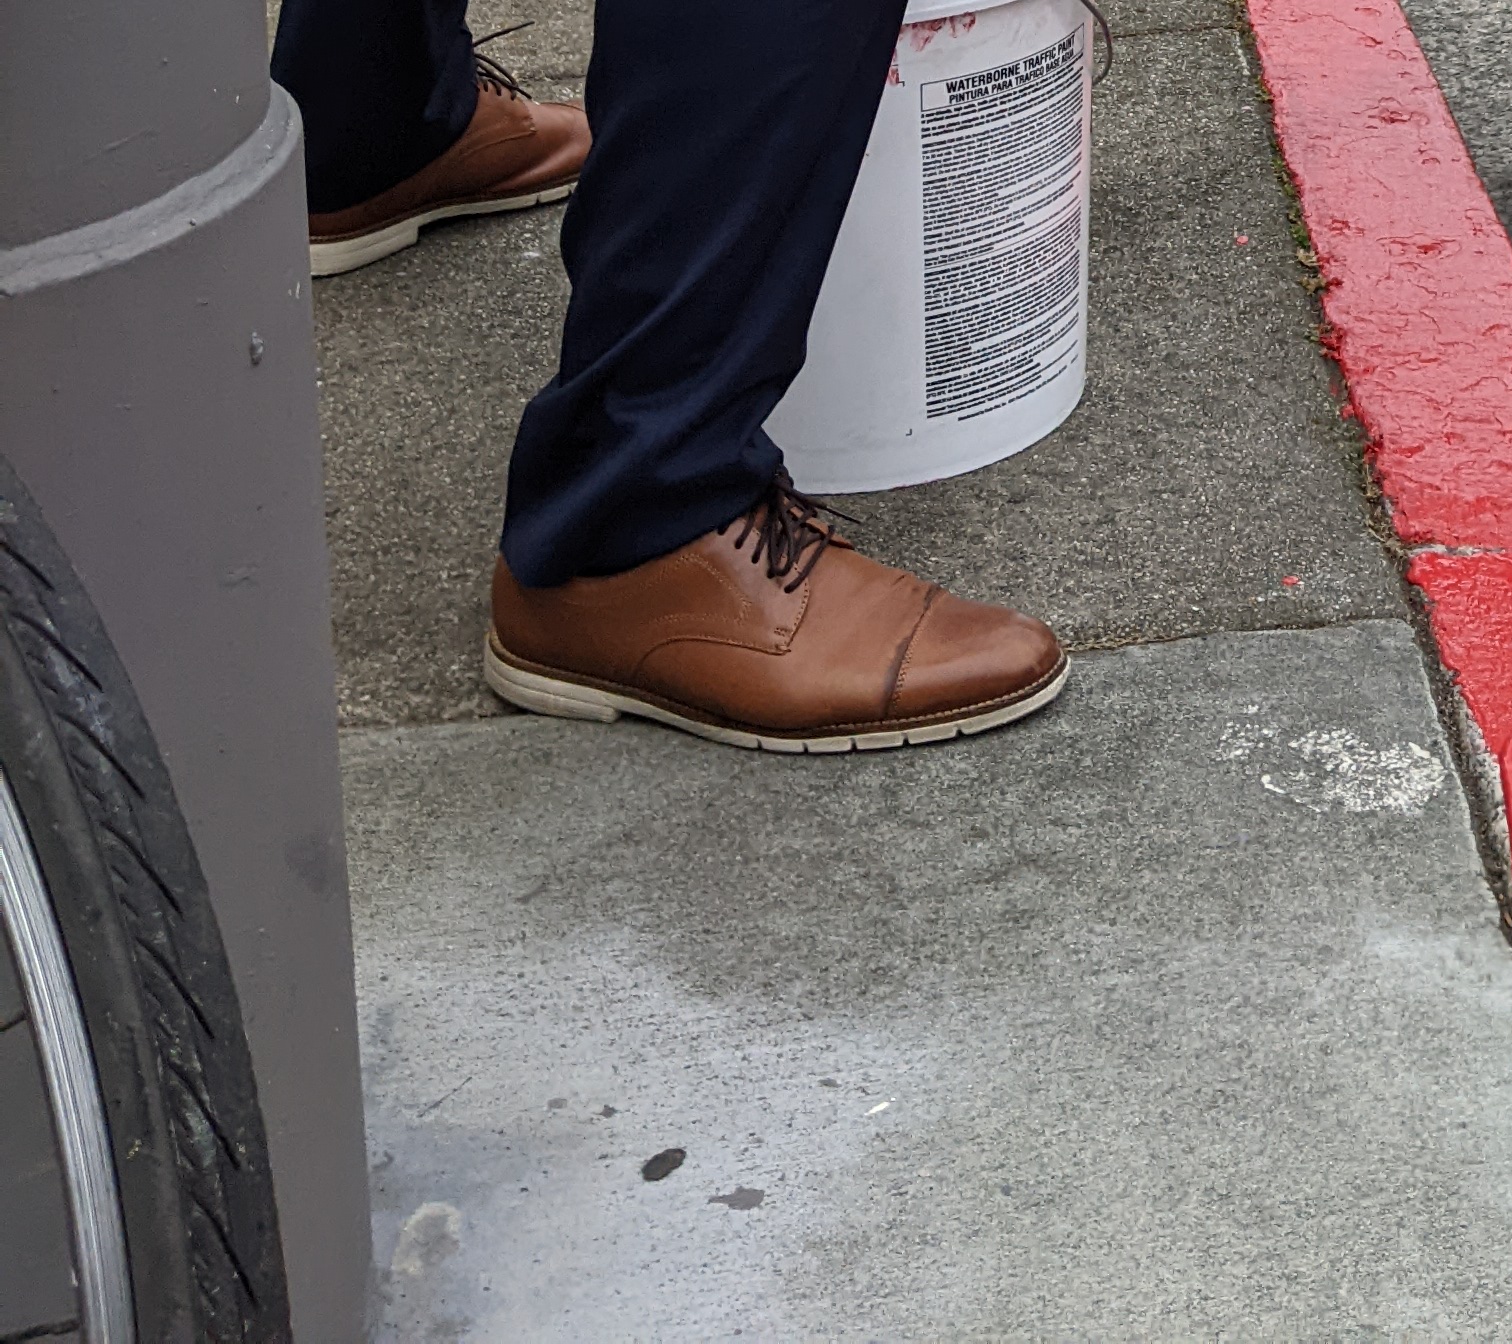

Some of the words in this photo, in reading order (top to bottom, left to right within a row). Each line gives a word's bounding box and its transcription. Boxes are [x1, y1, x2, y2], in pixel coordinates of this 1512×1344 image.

[945, 65, 1021, 94] WATERBORNE
[1023, 47, 1057, 72] TRAFFIC
[1057, 34, 1076, 56] PAINT
[949, 87, 990, 104] PINTURA
[991, 80, 1013, 95] PARA
[1015, 69, 1044, 88] TRAFICO
